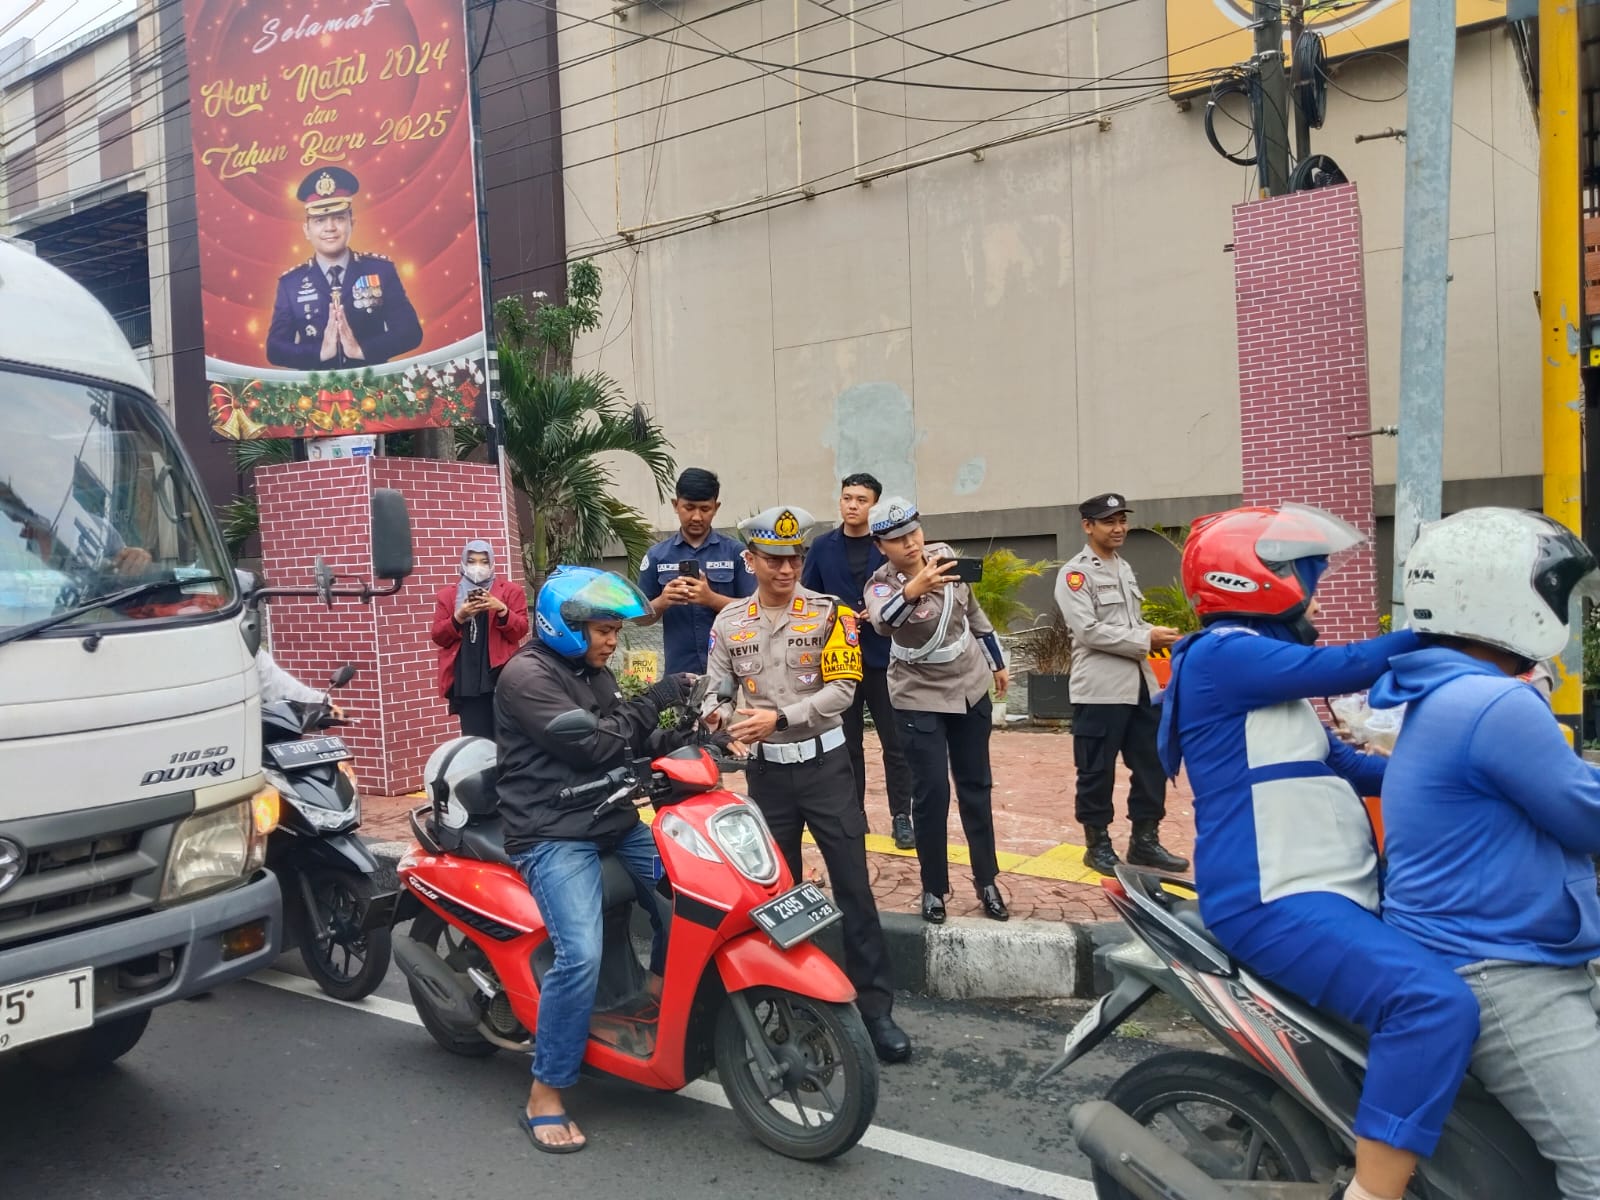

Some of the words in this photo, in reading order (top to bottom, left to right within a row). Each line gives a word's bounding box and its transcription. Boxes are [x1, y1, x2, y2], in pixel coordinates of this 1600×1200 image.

[252, 0, 391, 54] Selamat
[200, 74, 271, 117] Hari
[283, 54, 368, 102] Natal
[379, 39, 450, 80] 2024
[303, 105, 338, 126] dan
[202, 141, 288, 180] Tahun
[300, 130, 366, 166] Baru
[372, 109, 452, 146] 2025
[1208, 574, 1249, 588] INK
[1408, 569, 1435, 579] INK
[729, 644, 759, 657] KEVIN
[788, 637, 822, 647] POLRI
[823, 651, 839, 666] KA
[169, 750, 202, 764] 110
[201, 745, 229, 759] SD
[289, 742, 319, 754] 3075
[139, 757, 236, 786] DUTRO
[409, 876, 438, 900] Genio
[758, 912, 776, 928] N
[773, 896, 805, 919] 2395
[0, 989, 25, 1025] 5
[68, 974, 87, 1009] T
